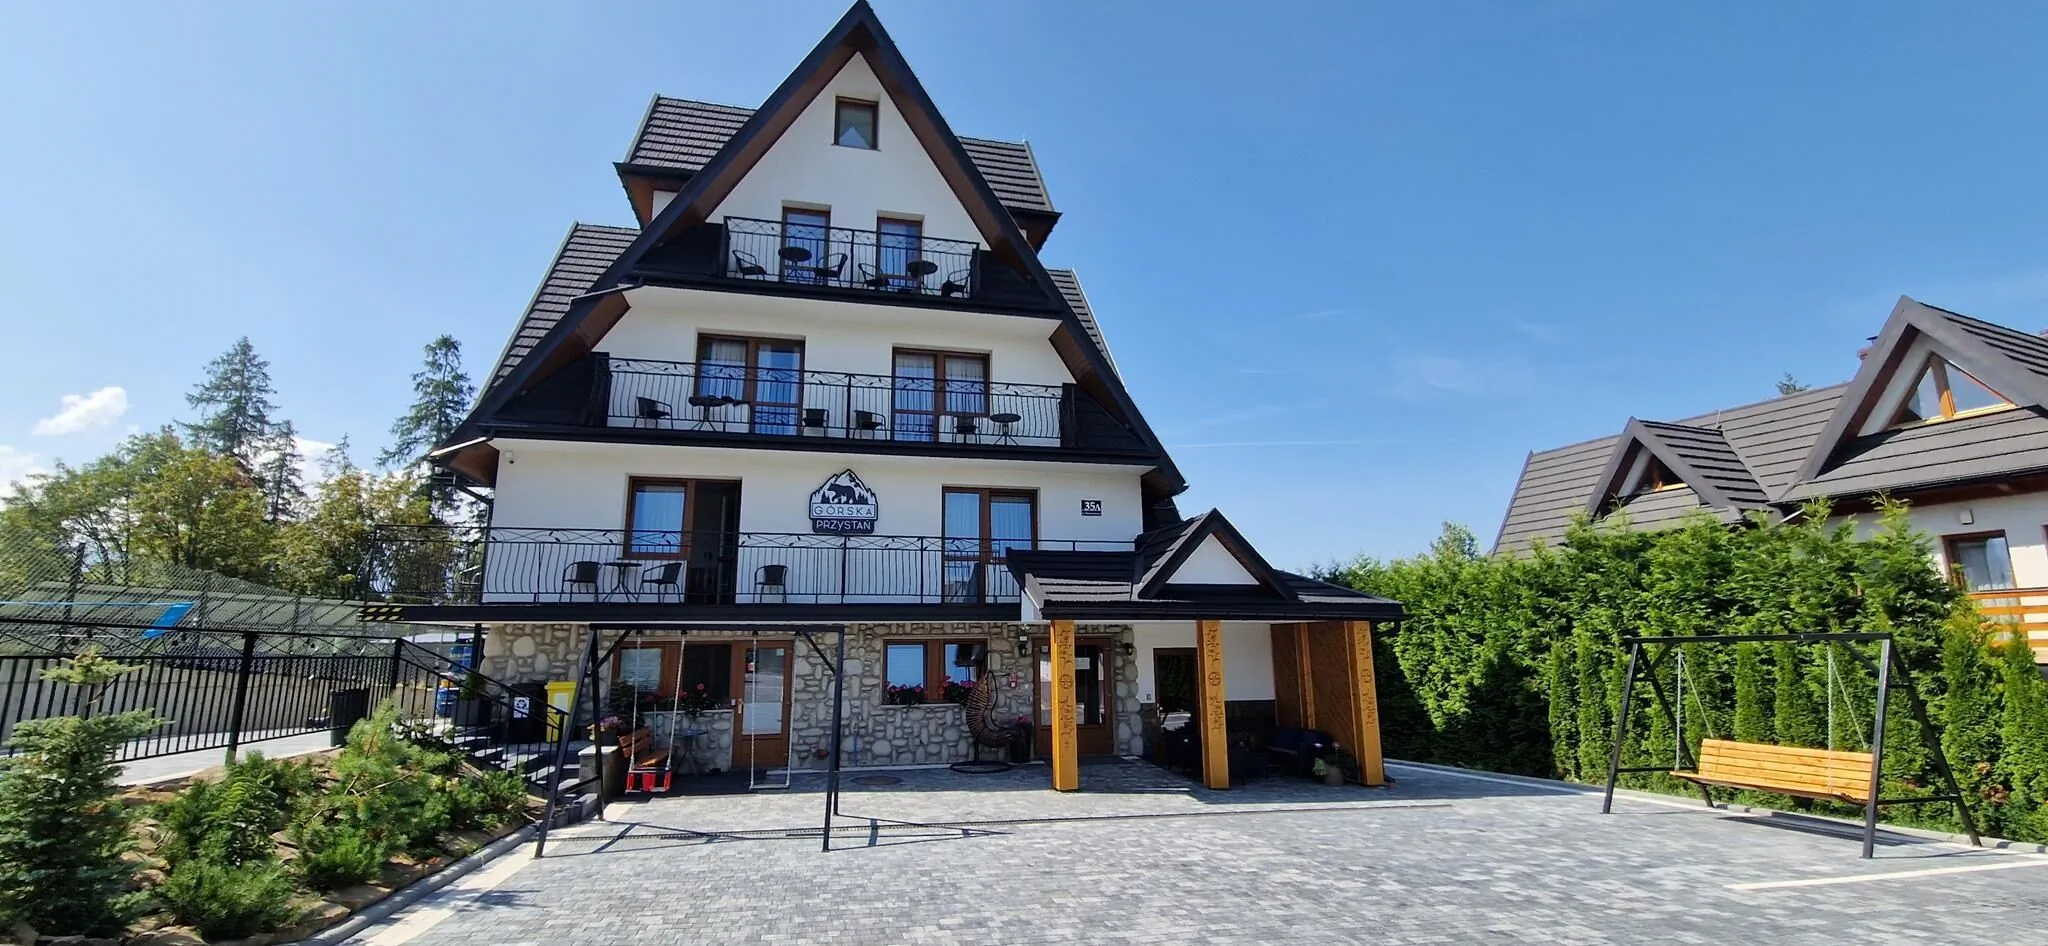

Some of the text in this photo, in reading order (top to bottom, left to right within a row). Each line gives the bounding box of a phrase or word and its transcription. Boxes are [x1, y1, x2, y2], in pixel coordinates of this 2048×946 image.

[814, 505, 872, 515] GÓRSKA
[1084, 501, 1101, 511] 35A
[816, 519, 871, 531] PRZYSTAŃ
